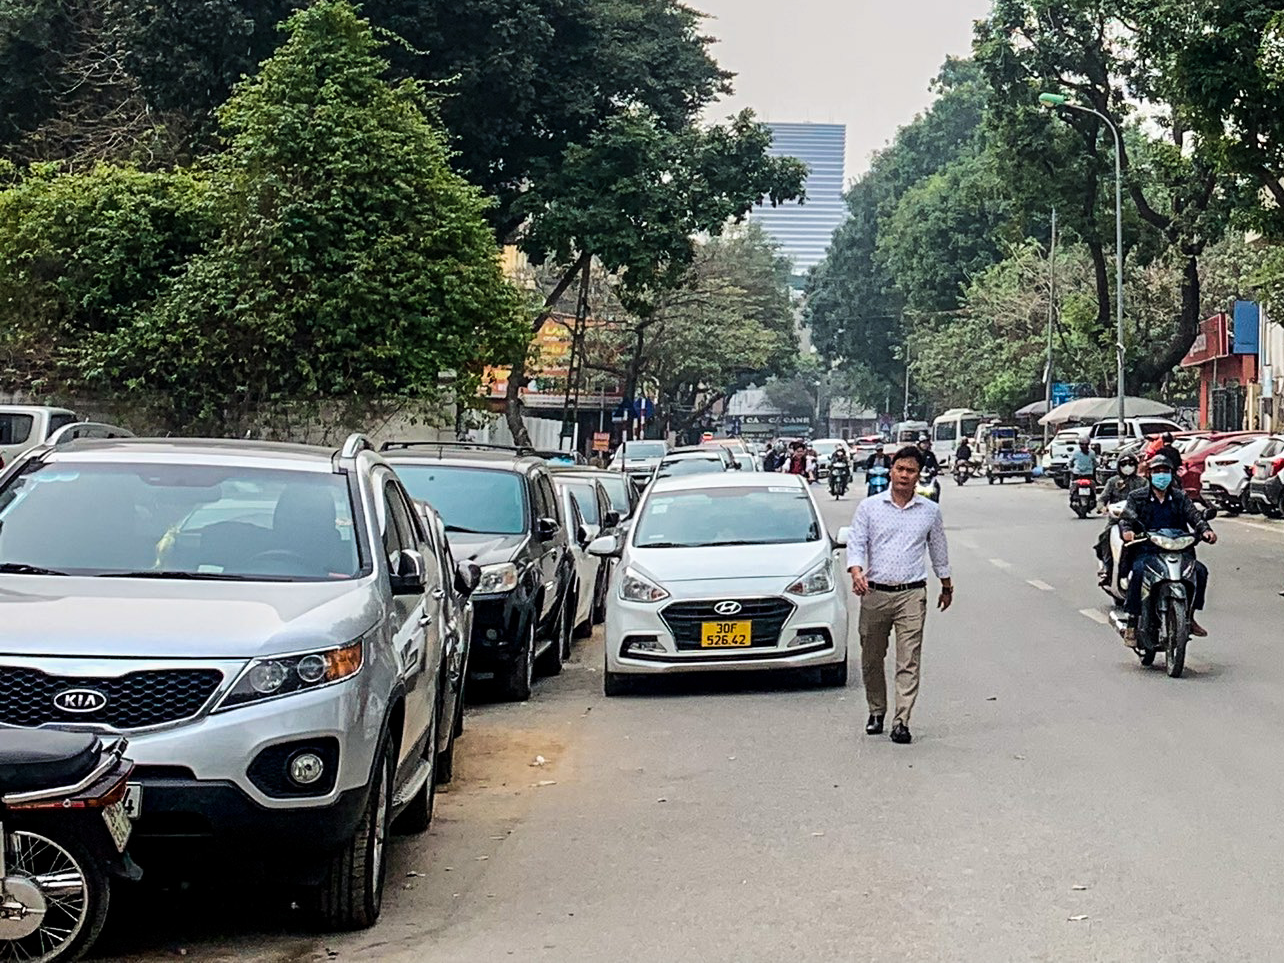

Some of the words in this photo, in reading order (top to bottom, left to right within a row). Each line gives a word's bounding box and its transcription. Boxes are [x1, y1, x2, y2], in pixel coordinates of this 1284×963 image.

[716, 622, 738, 634] 30F
[706, 634, 746, 645] 526.42
[64, 694, 97, 707] KIA
